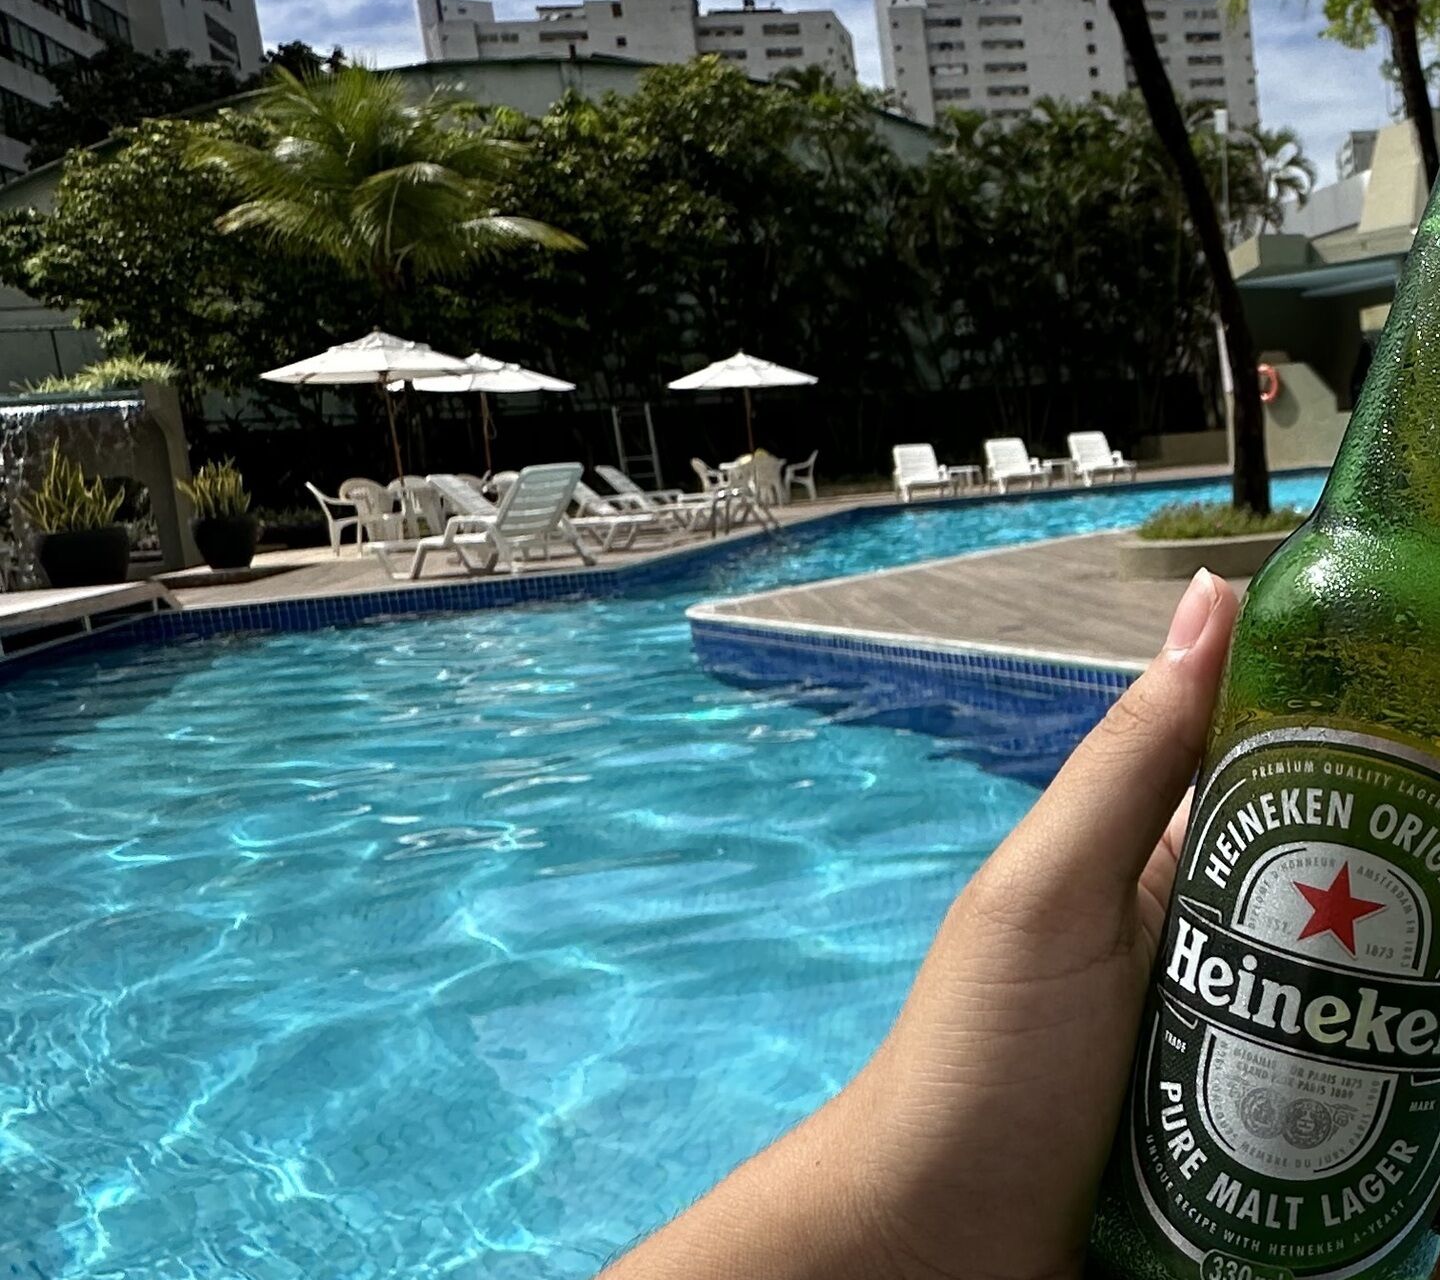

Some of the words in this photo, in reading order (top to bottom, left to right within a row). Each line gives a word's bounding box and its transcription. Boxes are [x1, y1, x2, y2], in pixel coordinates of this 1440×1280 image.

[1252, 760, 1314, 781] PREMIUM
[1323, 762, 1393, 788] QUALITY
[1204, 787, 1354, 889] HEINEKEN
[1356, 865, 1414, 916] AMSTERDAM
[1364, 943, 1395, 960] 1873
[1164, 1029, 1187, 1053] TRADE
[1297, 1080, 1327, 1096] PARIS
[1307, 1069, 1338, 1085] PARIS
[1409, 1100, 1436, 1112] MARK
[1160, 1081, 1208, 1181] PURE
[1205, 1172, 1304, 1230] MALT
[1321, 1139, 1420, 1227] LAGER
[1146, 1135, 1174, 1192] UNIQUE
[1174, 1193, 1217, 1235] RECIPE
[1223, 1228, 1260, 1253] WITH
[1268, 1239, 1345, 1257] HEINEKEN
